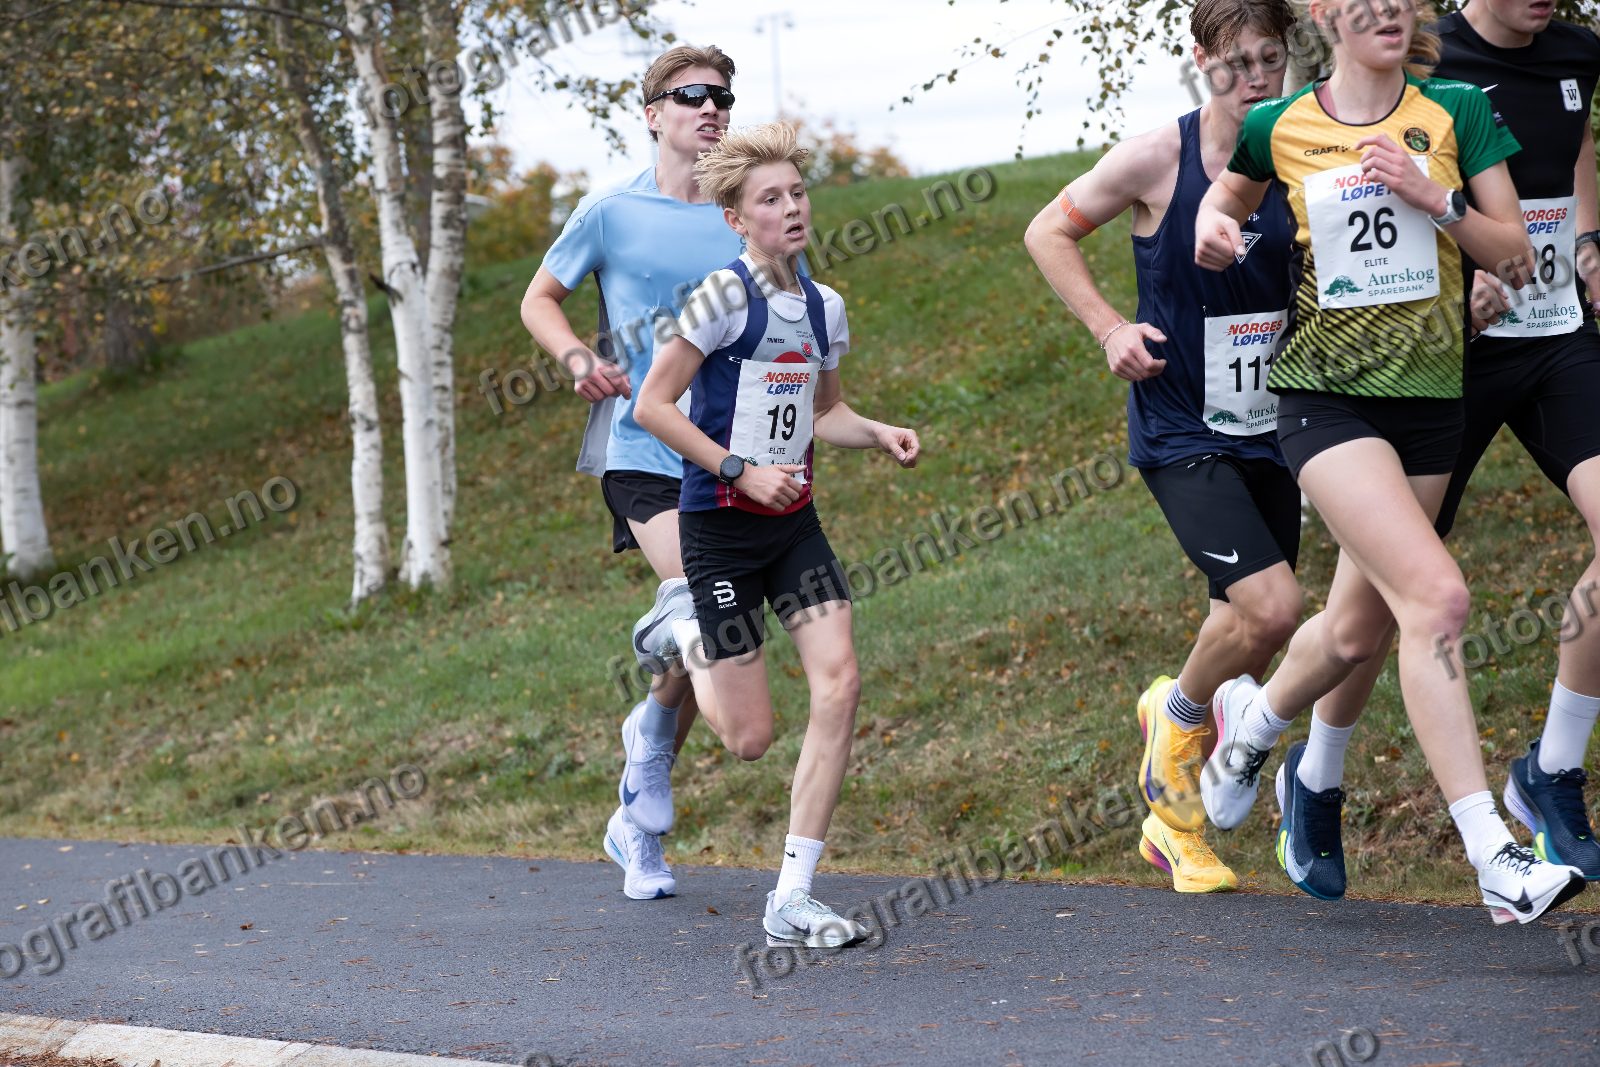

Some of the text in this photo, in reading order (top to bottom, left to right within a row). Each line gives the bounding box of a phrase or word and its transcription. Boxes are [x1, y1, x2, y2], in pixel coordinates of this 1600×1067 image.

[1304, 145, 1340, 157] CRAFT
[1335, 174, 1382, 189] NOR
[1348, 206, 1398, 253] 26
[1527, 220, 1560, 235] ØPET
[1364, 257, 1389, 268] ELITE
[1368, 267, 1435, 287] Aurskog
[1368, 283, 1425, 297] SPAREBANK
[1528, 292, 1547, 301] ELITE
[1527, 303, 1578, 320] Aurskog
[1228, 319, 1283, 336] NORGES
[1526, 319, 1568, 329] SPAREBANK
[1232, 332, 1276, 347] LØPET
[763, 371, 811, 384] NORGES
[766, 383, 803, 396] LØPET
[1246, 403, 1280, 421] Aursk
[767, 403, 797, 441] 19
[768, 447, 786, 455] ELITE
